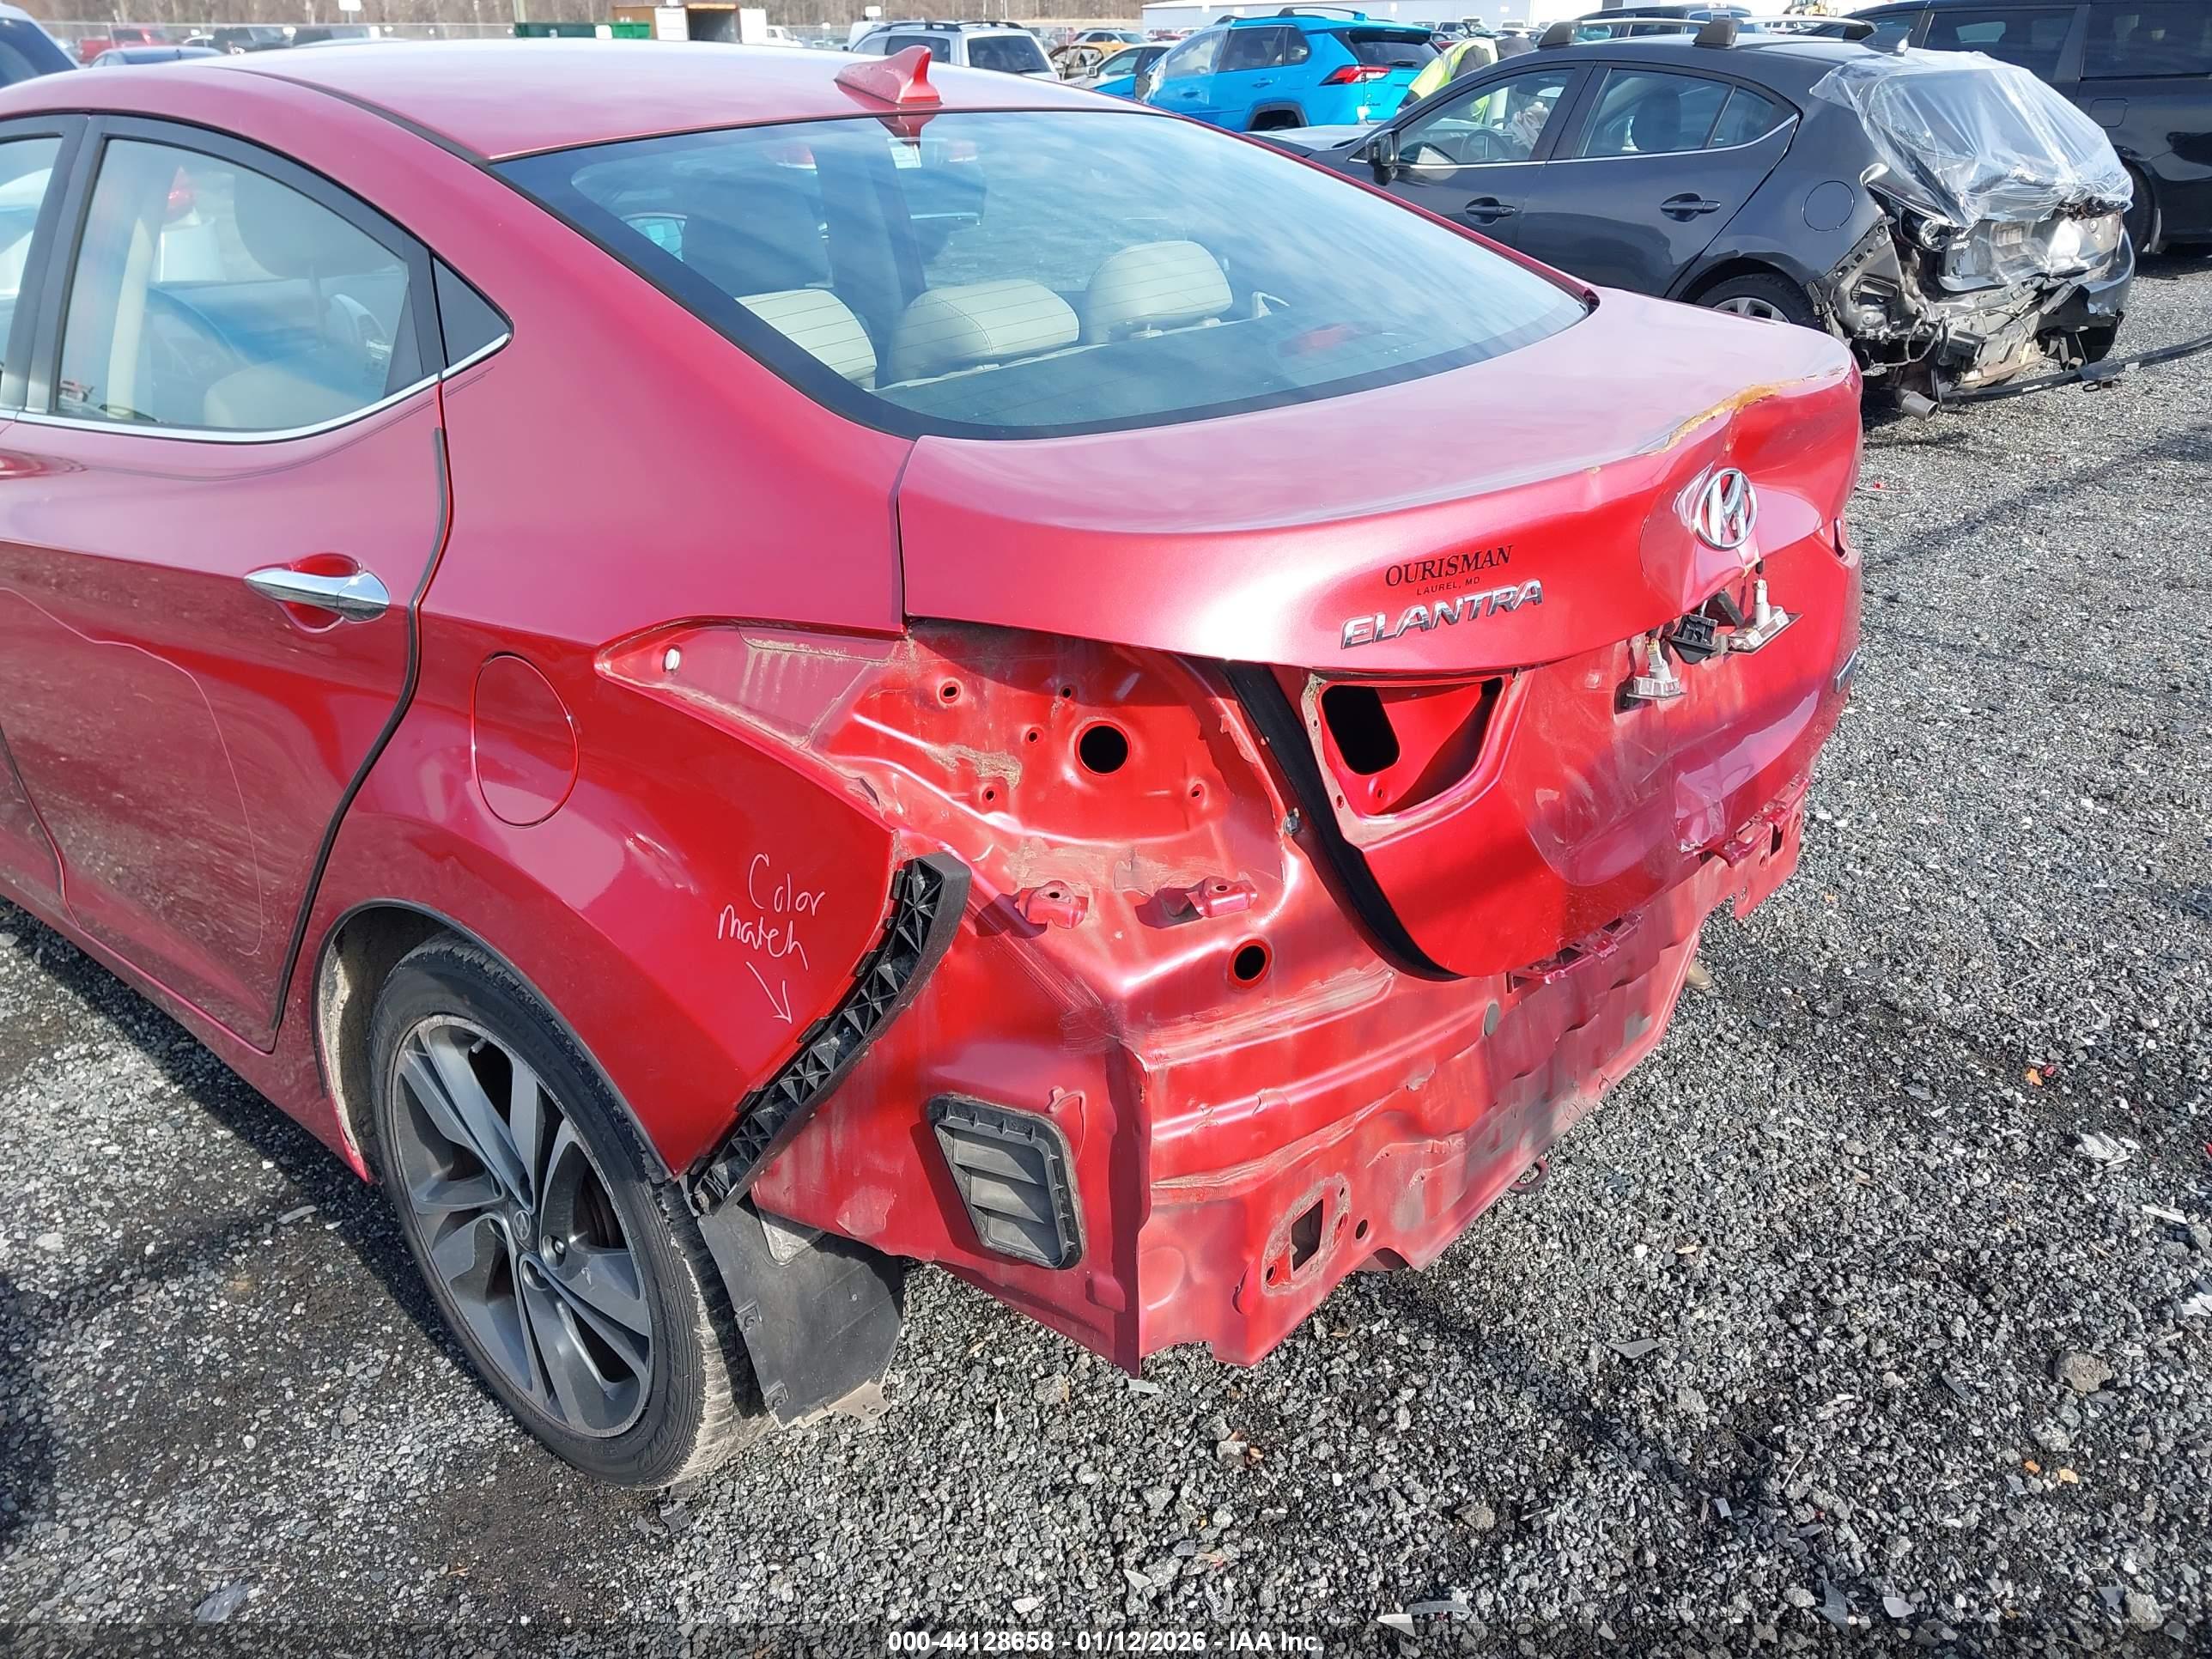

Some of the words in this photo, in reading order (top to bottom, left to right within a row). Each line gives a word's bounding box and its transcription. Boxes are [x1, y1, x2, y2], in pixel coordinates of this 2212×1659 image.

[1385, 544, 1514, 587] OURISMAN
[1416, 581, 1462, 597] LAUREL,
[1464, 576, 1481, 586] MD
[1340, 578, 1544, 650] ELANTRA
[748, 852, 826, 917] Color
